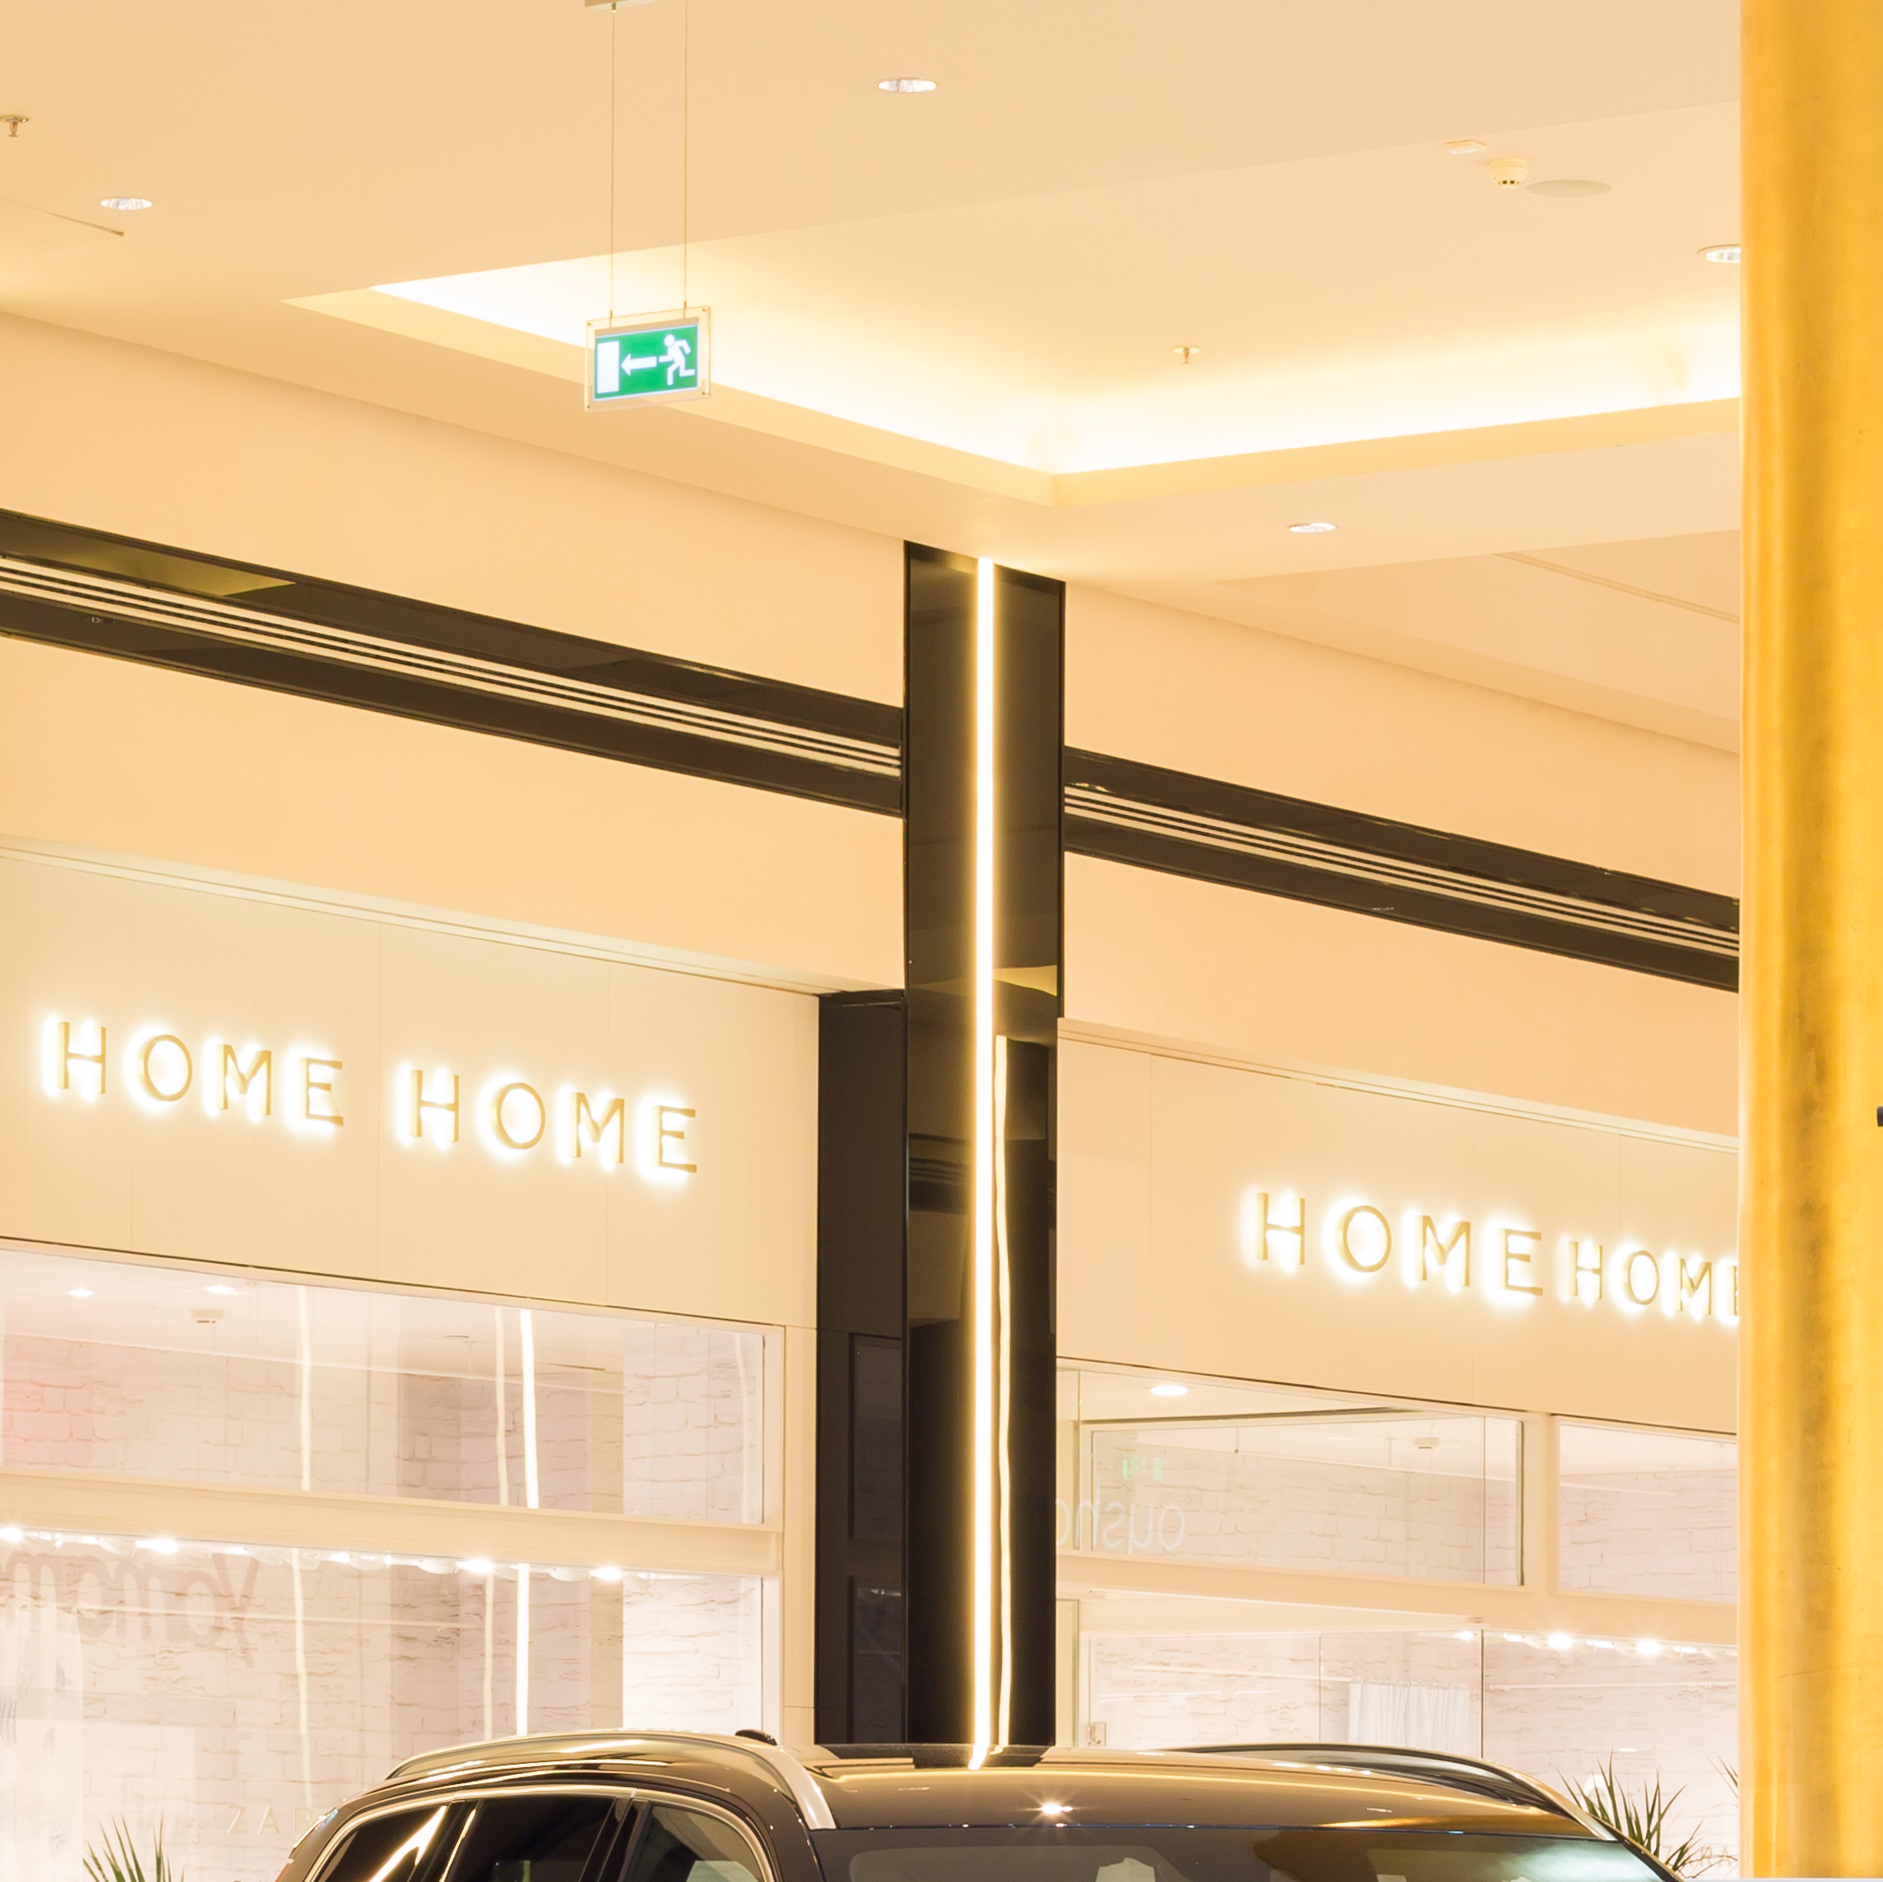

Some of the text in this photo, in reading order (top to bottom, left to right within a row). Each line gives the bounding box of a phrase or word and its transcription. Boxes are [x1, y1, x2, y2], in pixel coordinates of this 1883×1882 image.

[55, 1020, 699, 1175] HOME HOME
[1255, 1192, 1544, 1298] HOME
